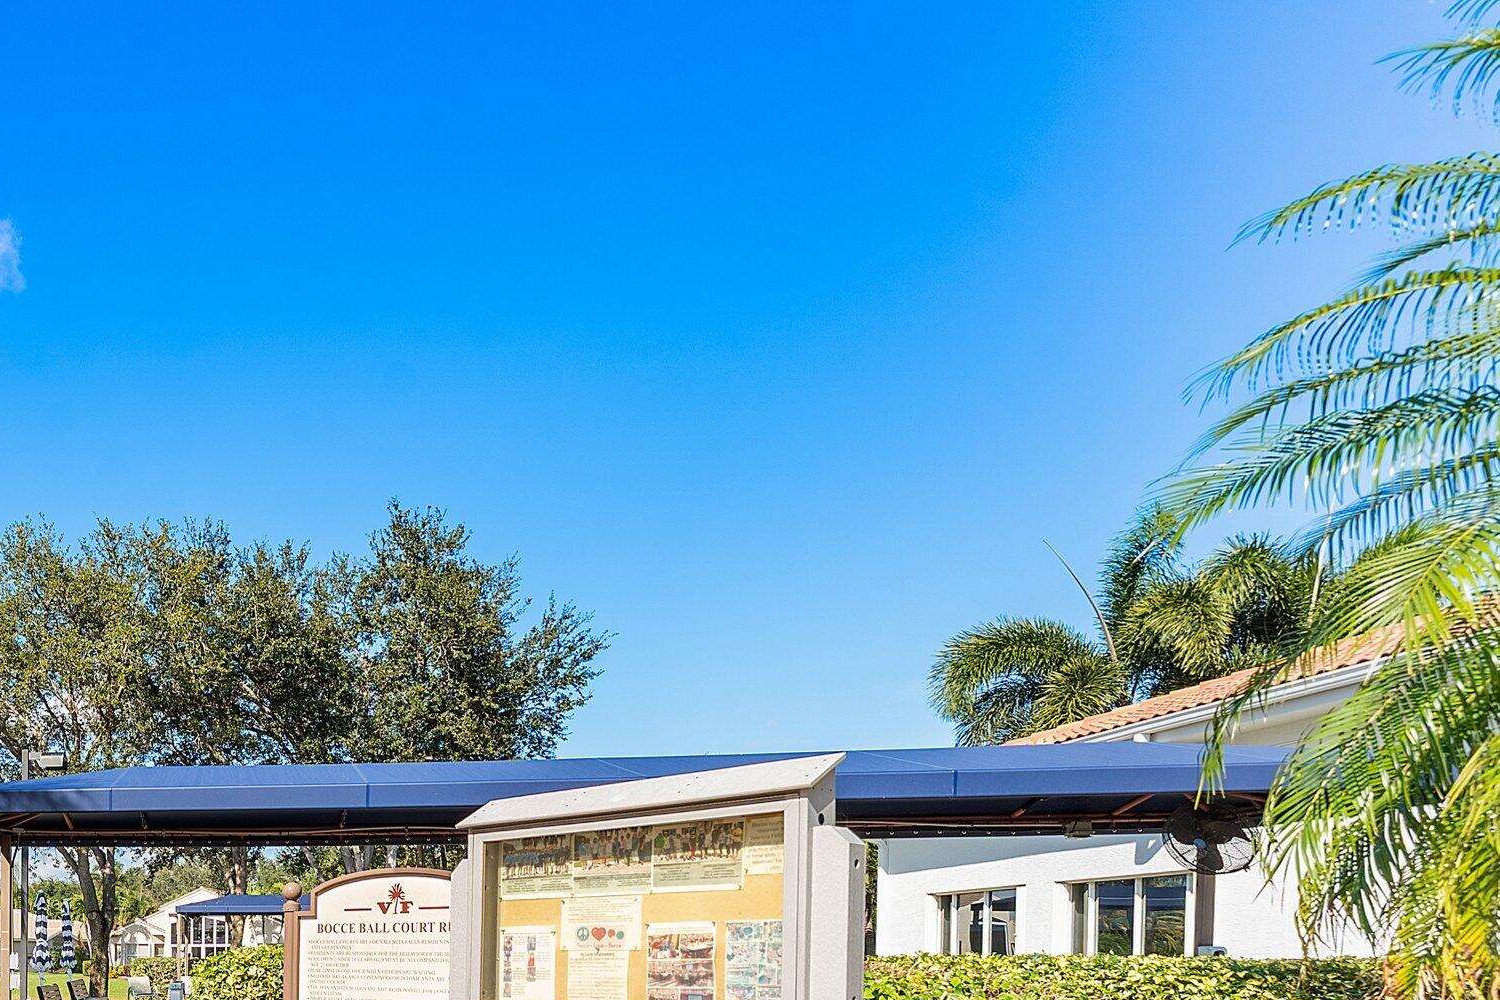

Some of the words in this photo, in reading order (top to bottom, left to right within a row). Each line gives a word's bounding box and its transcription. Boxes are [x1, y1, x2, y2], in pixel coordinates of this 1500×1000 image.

[317, 923, 356, 934] BOCCE
[359, 922, 390, 933] BALL
[392, 922, 436, 933] COURT
